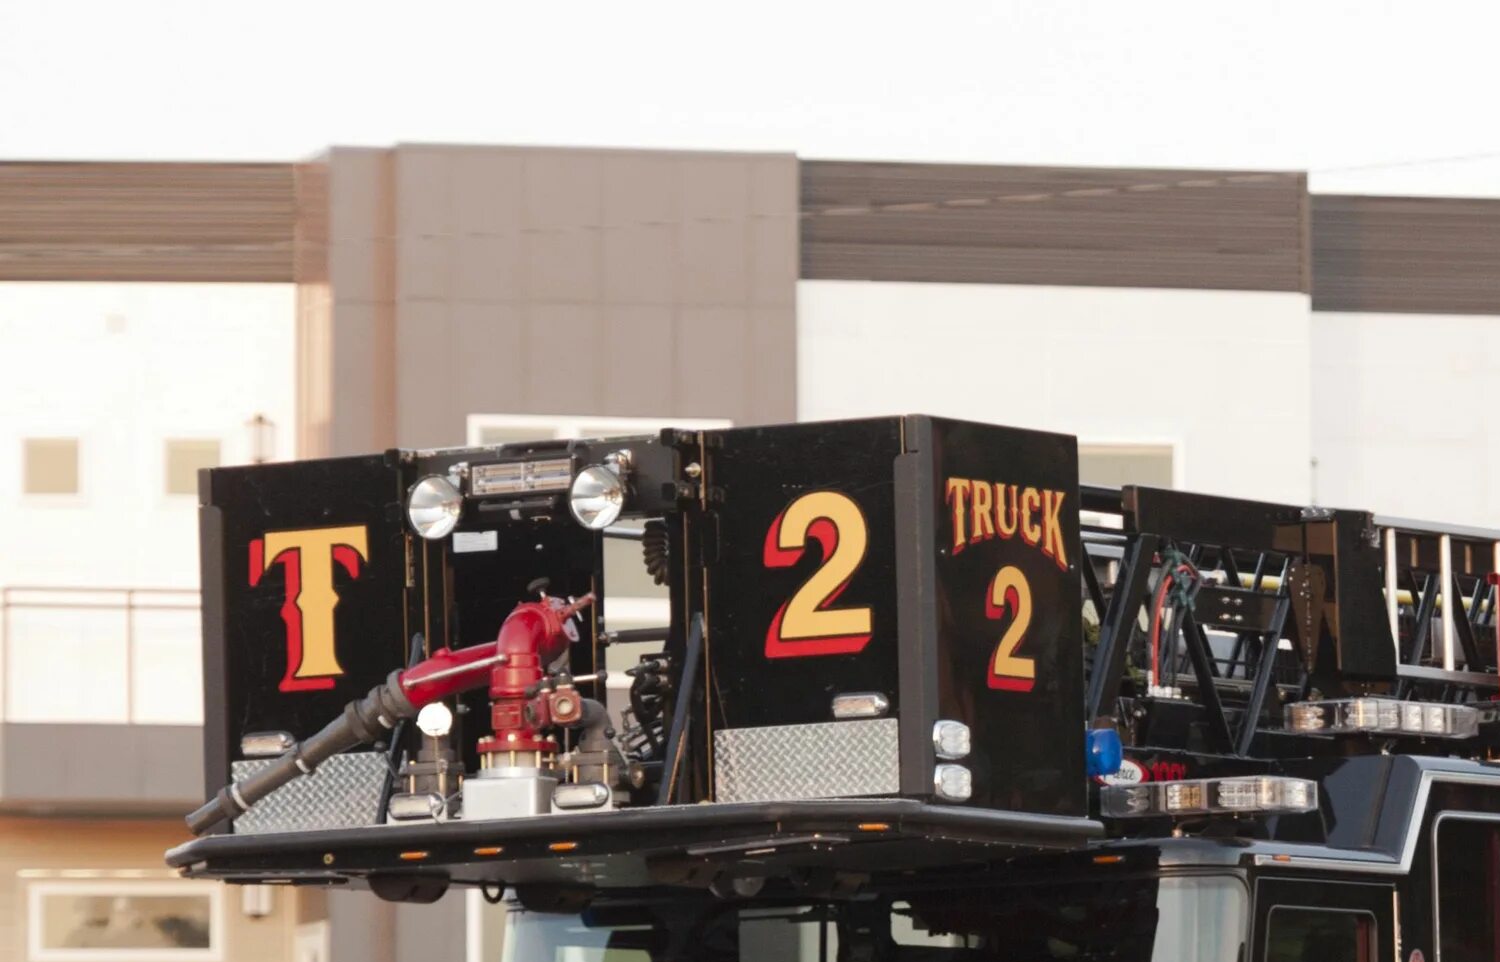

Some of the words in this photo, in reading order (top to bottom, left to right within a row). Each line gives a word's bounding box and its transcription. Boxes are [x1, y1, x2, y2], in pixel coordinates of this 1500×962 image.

[763, 491, 872, 658] 2
[946, 478, 1068, 572] TRUCK
[248, 525, 369, 692] T
[986, 566, 1036, 692] 2
